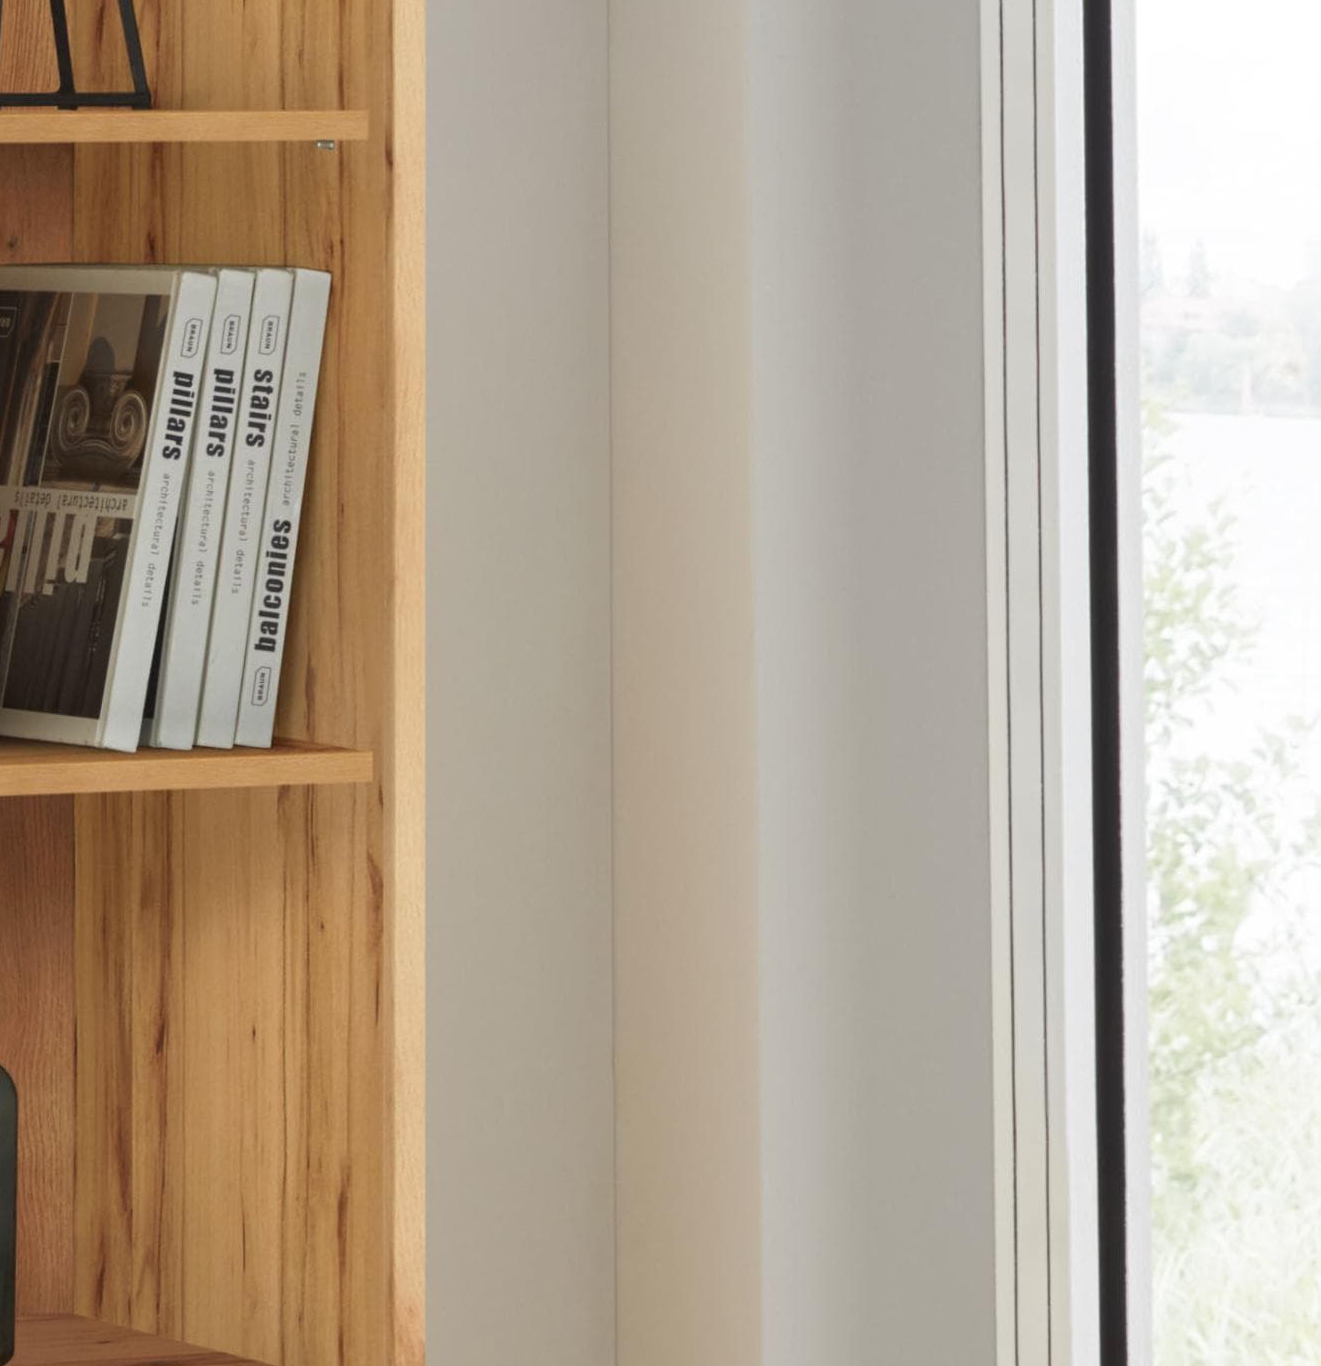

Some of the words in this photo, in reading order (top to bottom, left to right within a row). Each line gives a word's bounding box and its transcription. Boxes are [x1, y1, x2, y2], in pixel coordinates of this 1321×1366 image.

[186, 324, 197, 352] BRAUN
[226, 321, 235, 349] BRAUN
[264, 321, 274, 349] BRAUN
[163, 371, 195, 461] pillars
[206, 368, 236, 458] pillars
[245, 369, 273, 448] stairs
[15, 491, 51, 507] details
[58, 494, 127, 511] architectural
[150, 473, 170, 555] architectural
[198, 471, 215, 553] architectural
[238, 460, 256, 541] architectural
[254, 519, 292, 653] balconies
[282, 424, 300, 506] architectural
[292, 372, 307, 416] details
[141, 563, 156, 607] details
[191, 561, 204, 605] details
[231, 549, 245, 594] details
